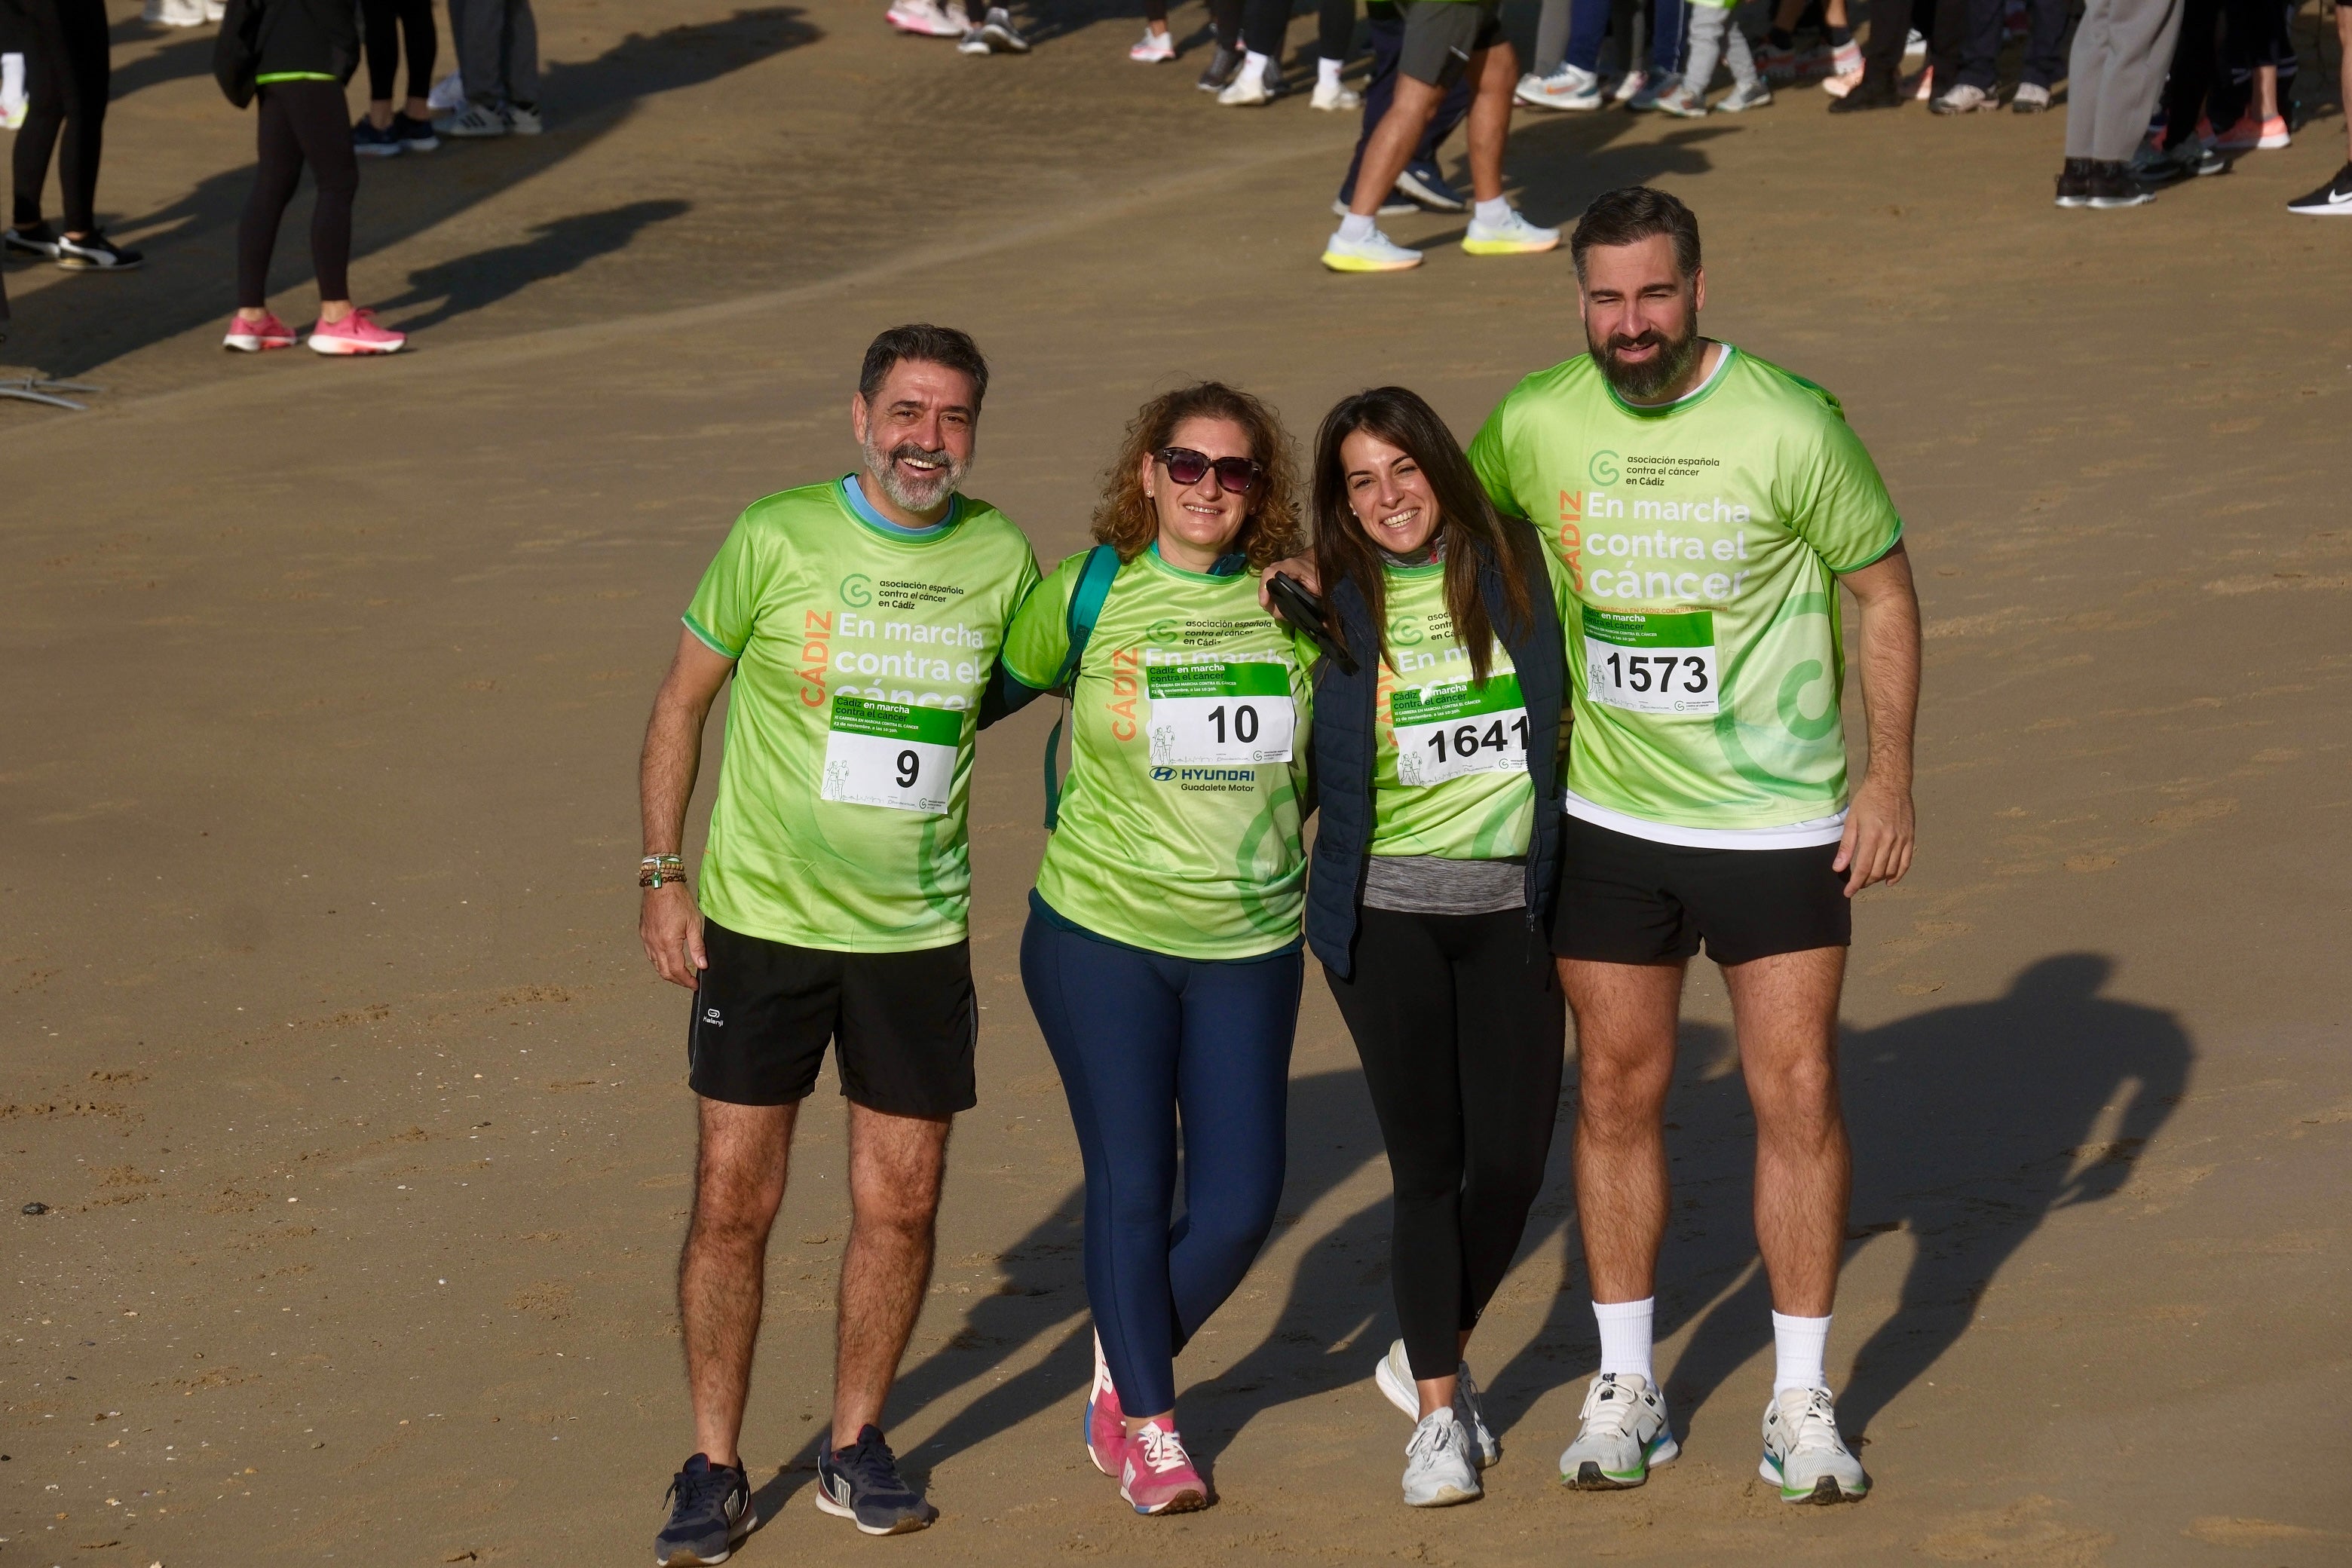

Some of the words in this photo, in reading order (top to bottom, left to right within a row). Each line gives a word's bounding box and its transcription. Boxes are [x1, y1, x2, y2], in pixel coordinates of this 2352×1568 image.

[1628, 456, 1675, 464] asociación
[1677, 458, 1720, 467] española
[1668, 467, 1699, 476] cáncer
[1640, 477, 1664, 485] Cádiz
[1588, 492, 1625, 518] En
[1633, 498, 1750, 523] marcha
[1586, 529, 1706, 560] contra
[1712, 531, 1749, 561] el
[880, 580, 926, 590] asociación
[929, 583, 964, 594] española
[1590, 560, 1750, 600] cáncer
[879, 590, 908, 599] contra
[919, 593, 947, 602] cáncer
[892, 600, 915, 609] Cádiz
[1186, 620, 1233, 628] asociación
[1612, 614, 1646, 622] marcha
[839, 612, 875, 638] En
[884, 621, 984, 649] marcha
[1429, 620, 1453, 631] contr
[1615, 622, 1645, 630] cáncer
[794, 609, 832, 707] CÁDIZ
[1146, 648, 1182, 666] En
[1397, 650, 1435, 673] En
[835, 651, 951, 681] contra
[955, 657, 982, 684] el
[1191, 663, 1225, 672] marcha
[1606, 652, 1708, 694] 1573
[1150, 674, 1180, 682] contra
[1193, 672, 1224, 680] cáncer
[1106, 648, 1138, 742] CÁDIZ
[1393, 691, 1417, 700] Cádiz
[1433, 684, 1467, 695] marcha
[837, 697, 862, 707] Cádiz
[877, 703, 910, 714] marcha
[1394, 700, 1423, 709] contra
[1435, 694, 1467, 703] cáncer
[835, 707, 865, 716] contra
[877, 712, 908, 721] cáncer
[1208, 705, 1259, 743] 10
[1428, 715, 1529, 763] 1641
[896, 749, 919, 789] 9
[1181, 768, 1254, 781] HYUNDAI
[1181, 783, 1227, 792] Guadalete
[1228, 783, 1254, 792] Motor
[703, 1015, 724, 1027] Kalenji
